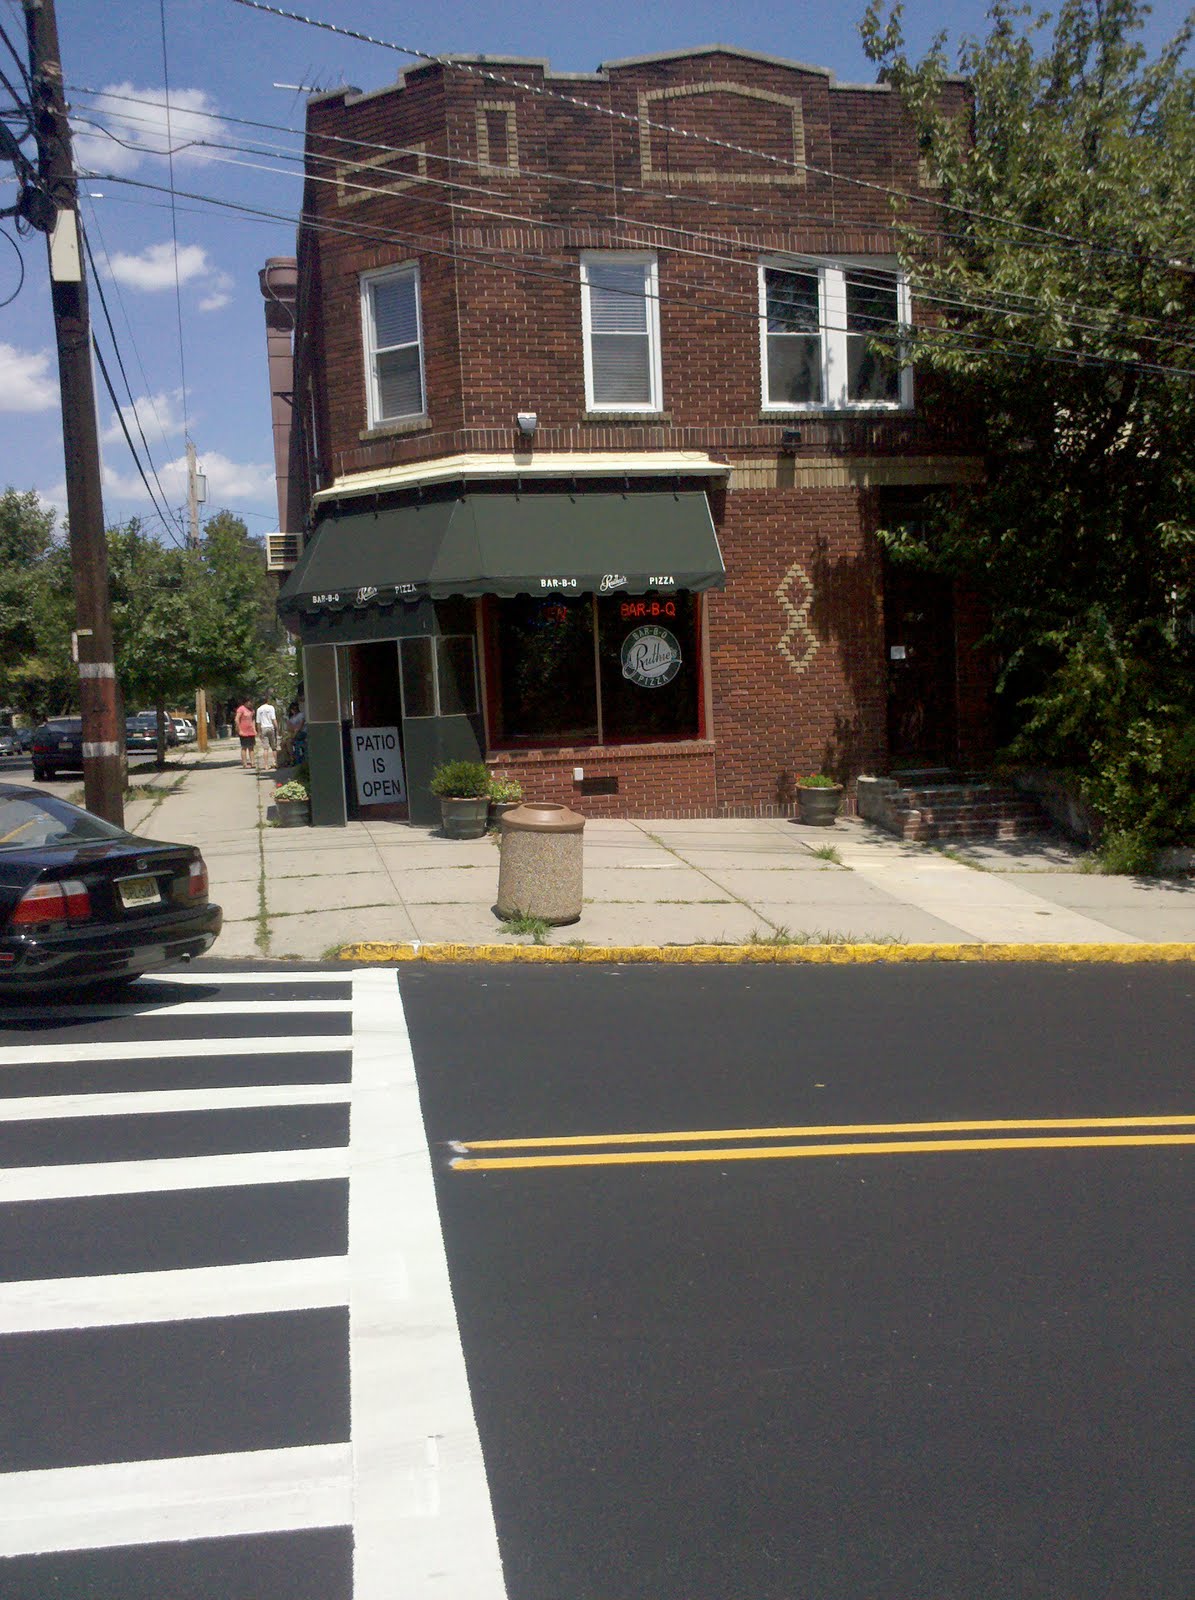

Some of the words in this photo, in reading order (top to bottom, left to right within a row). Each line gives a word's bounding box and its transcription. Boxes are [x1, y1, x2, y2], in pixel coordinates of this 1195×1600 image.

[394, 583, 417, 594] PIZZA
[540, 578, 577, 588] BAR-B-Q
[649, 576, 675, 585] PIZZA
[620, 601, 676, 617] BAR-B-Q
[638, 674, 669, 686] PIZZA
[356, 734, 396, 751] PATIO
[372, 757, 386, 774] IS
[362, 780, 402, 797] OPEN
